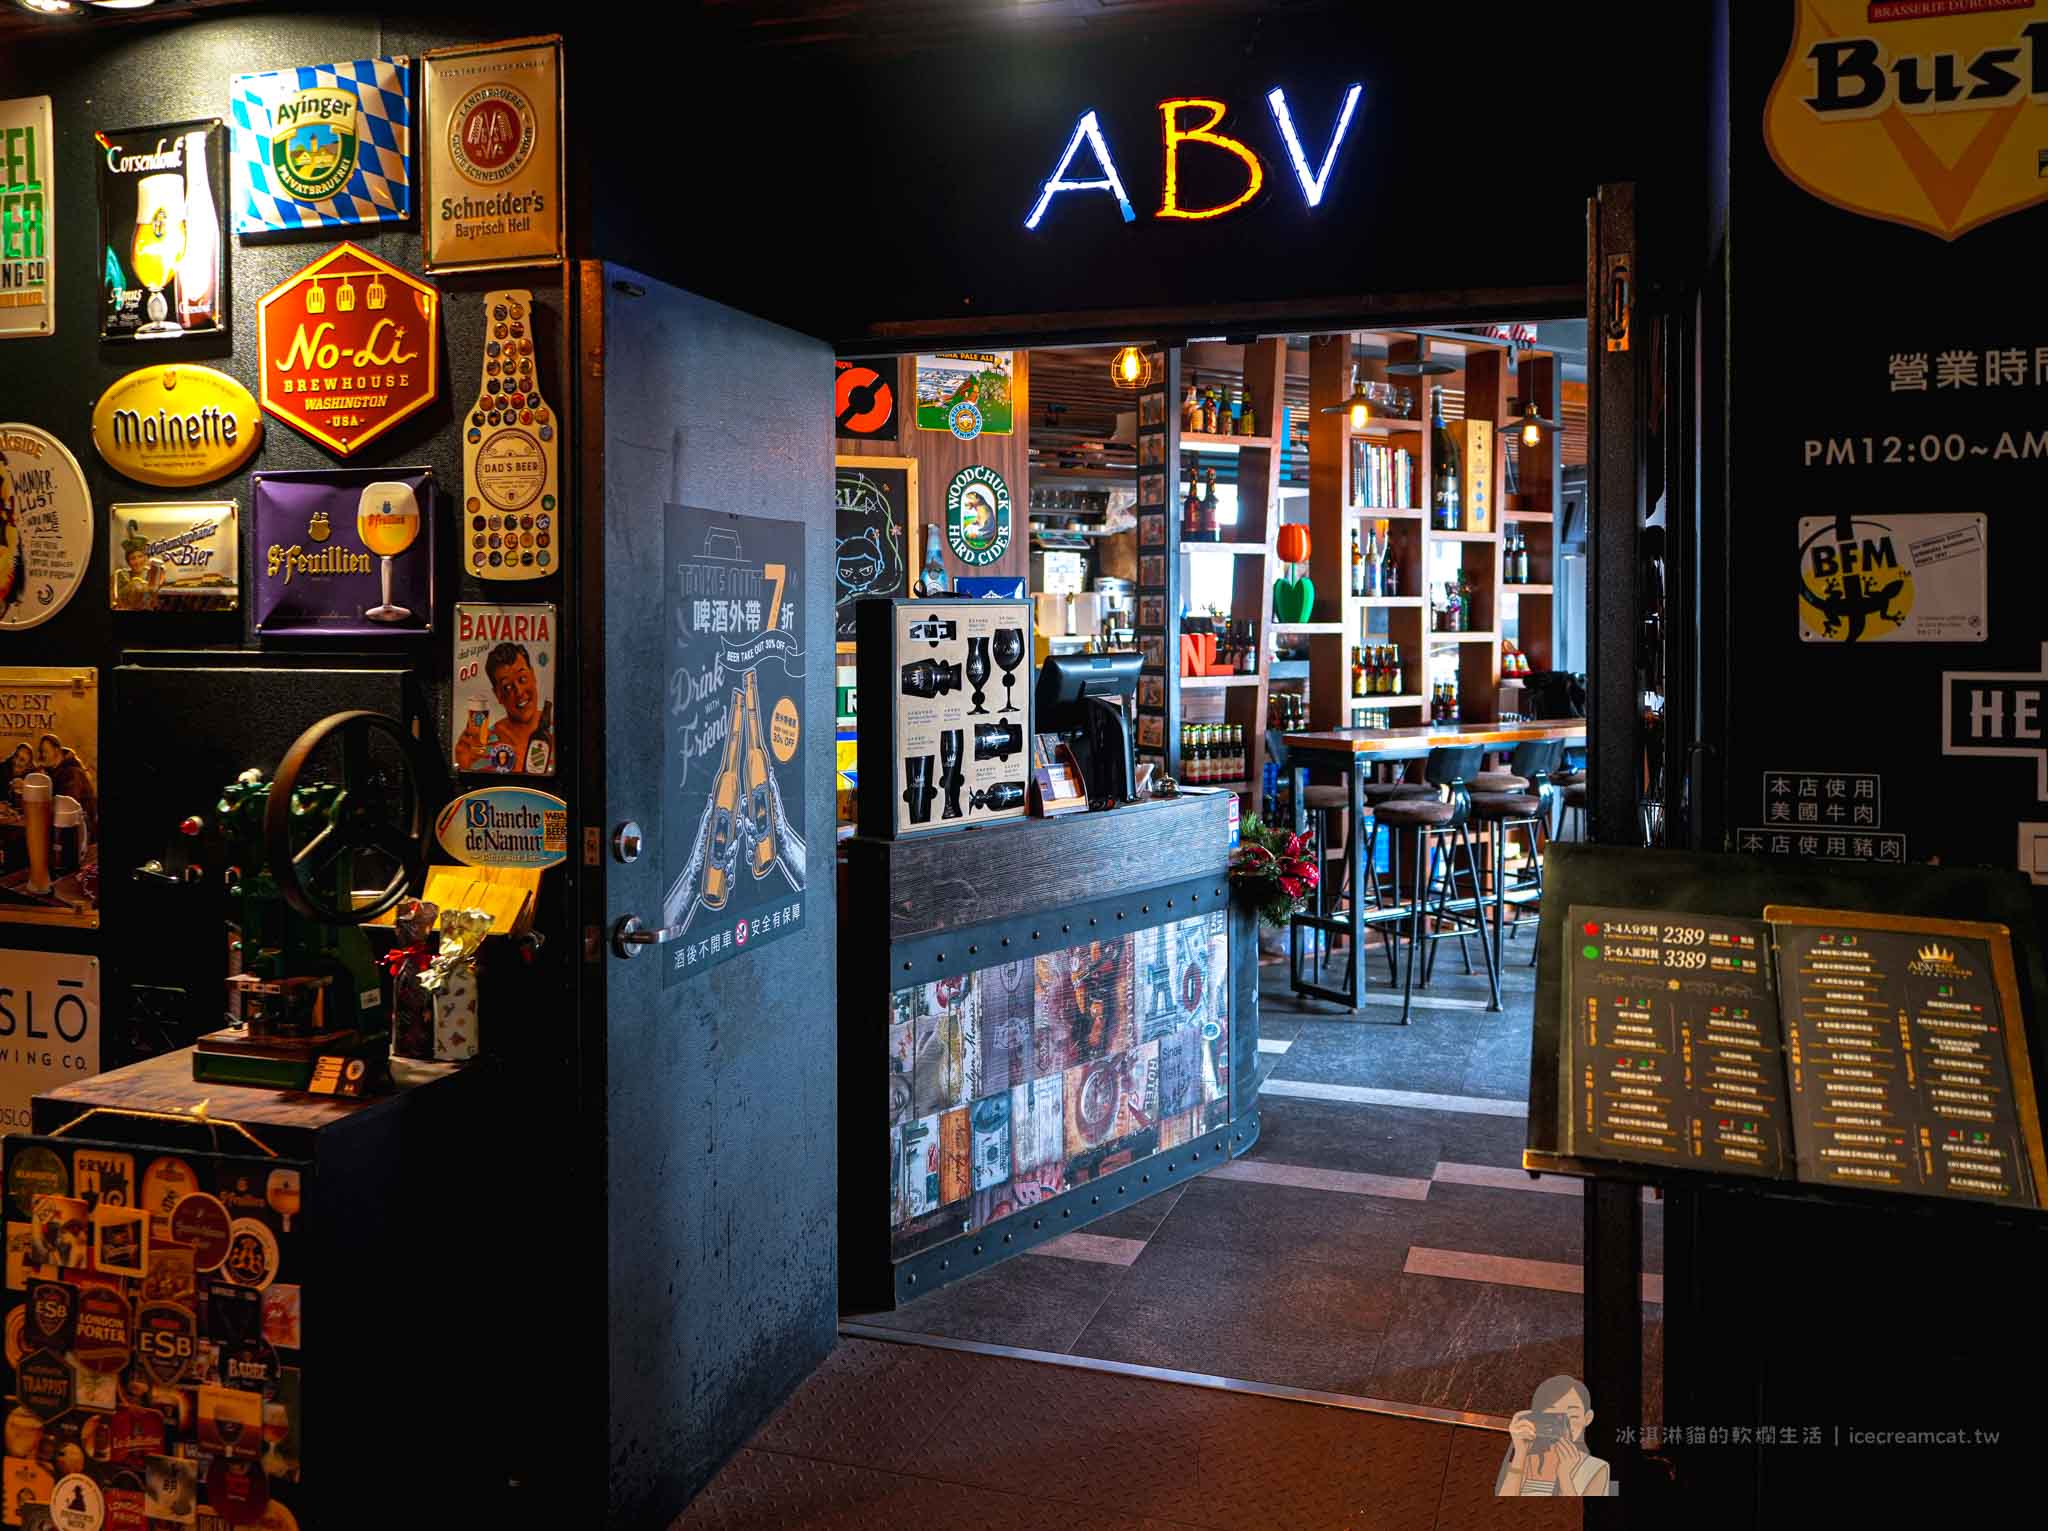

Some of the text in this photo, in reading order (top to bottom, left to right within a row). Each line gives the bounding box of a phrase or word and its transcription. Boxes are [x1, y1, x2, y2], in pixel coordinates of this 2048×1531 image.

[277, 95, 353, 125] Ayinger
[1024, 82, 1362, 230] ABV
[441, 189, 545, 221] Schneider's
[455, 216, 530, 240] Bayrisch Hell
[275, 318, 418, 372] No-Li
[283, 375, 409, 393] BREWHOUSE
[305, 395, 388, 411] WASHINGTON
[113, 407, 237, 448] Moinette
[485, 461, 538, 474] DAD'S BEER
[948, 465, 1010, 511] WOODCHUCK
[18, 491, 55, 514] LUST
[173, 544, 214, 566] Bier
[949, 524, 1010, 566] HARD CIDER
[1809, 535, 1898, 578] BFM
[460, 614, 549, 641] BAVARIA
[726, 638, 786, 663] BEER TAKE OUT 30% OFF
[1180, 633, 1234, 677] NL
[460, 662, 479, 681] 0.0
[671, 654, 727, 715] Drink
[704, 699, 721, 714] WITH
[1971, 690, 2041, 738] HE
[677, 705, 729, 788] Friend
[1769, 776, 1874, 799] 本店使用
[468, 799, 541, 829] Blanche
[1770, 802, 1874, 823] 美國牛肉
[1743, 834, 1900, 859] 本店使用豬肉
[751, 903, 801, 937] 安全有保障
[1662, 926, 1705, 945] 2389
[673, 931, 732, 969] 酒後不開車
[1663, 949, 1707, 969] 3389
[35, 1300, 67, 1318] ESB
[79, 1312, 125, 1329] LONDON
[76, 1325, 127, 1344] PORTER
[139, 1331, 192, 1358] ESB
